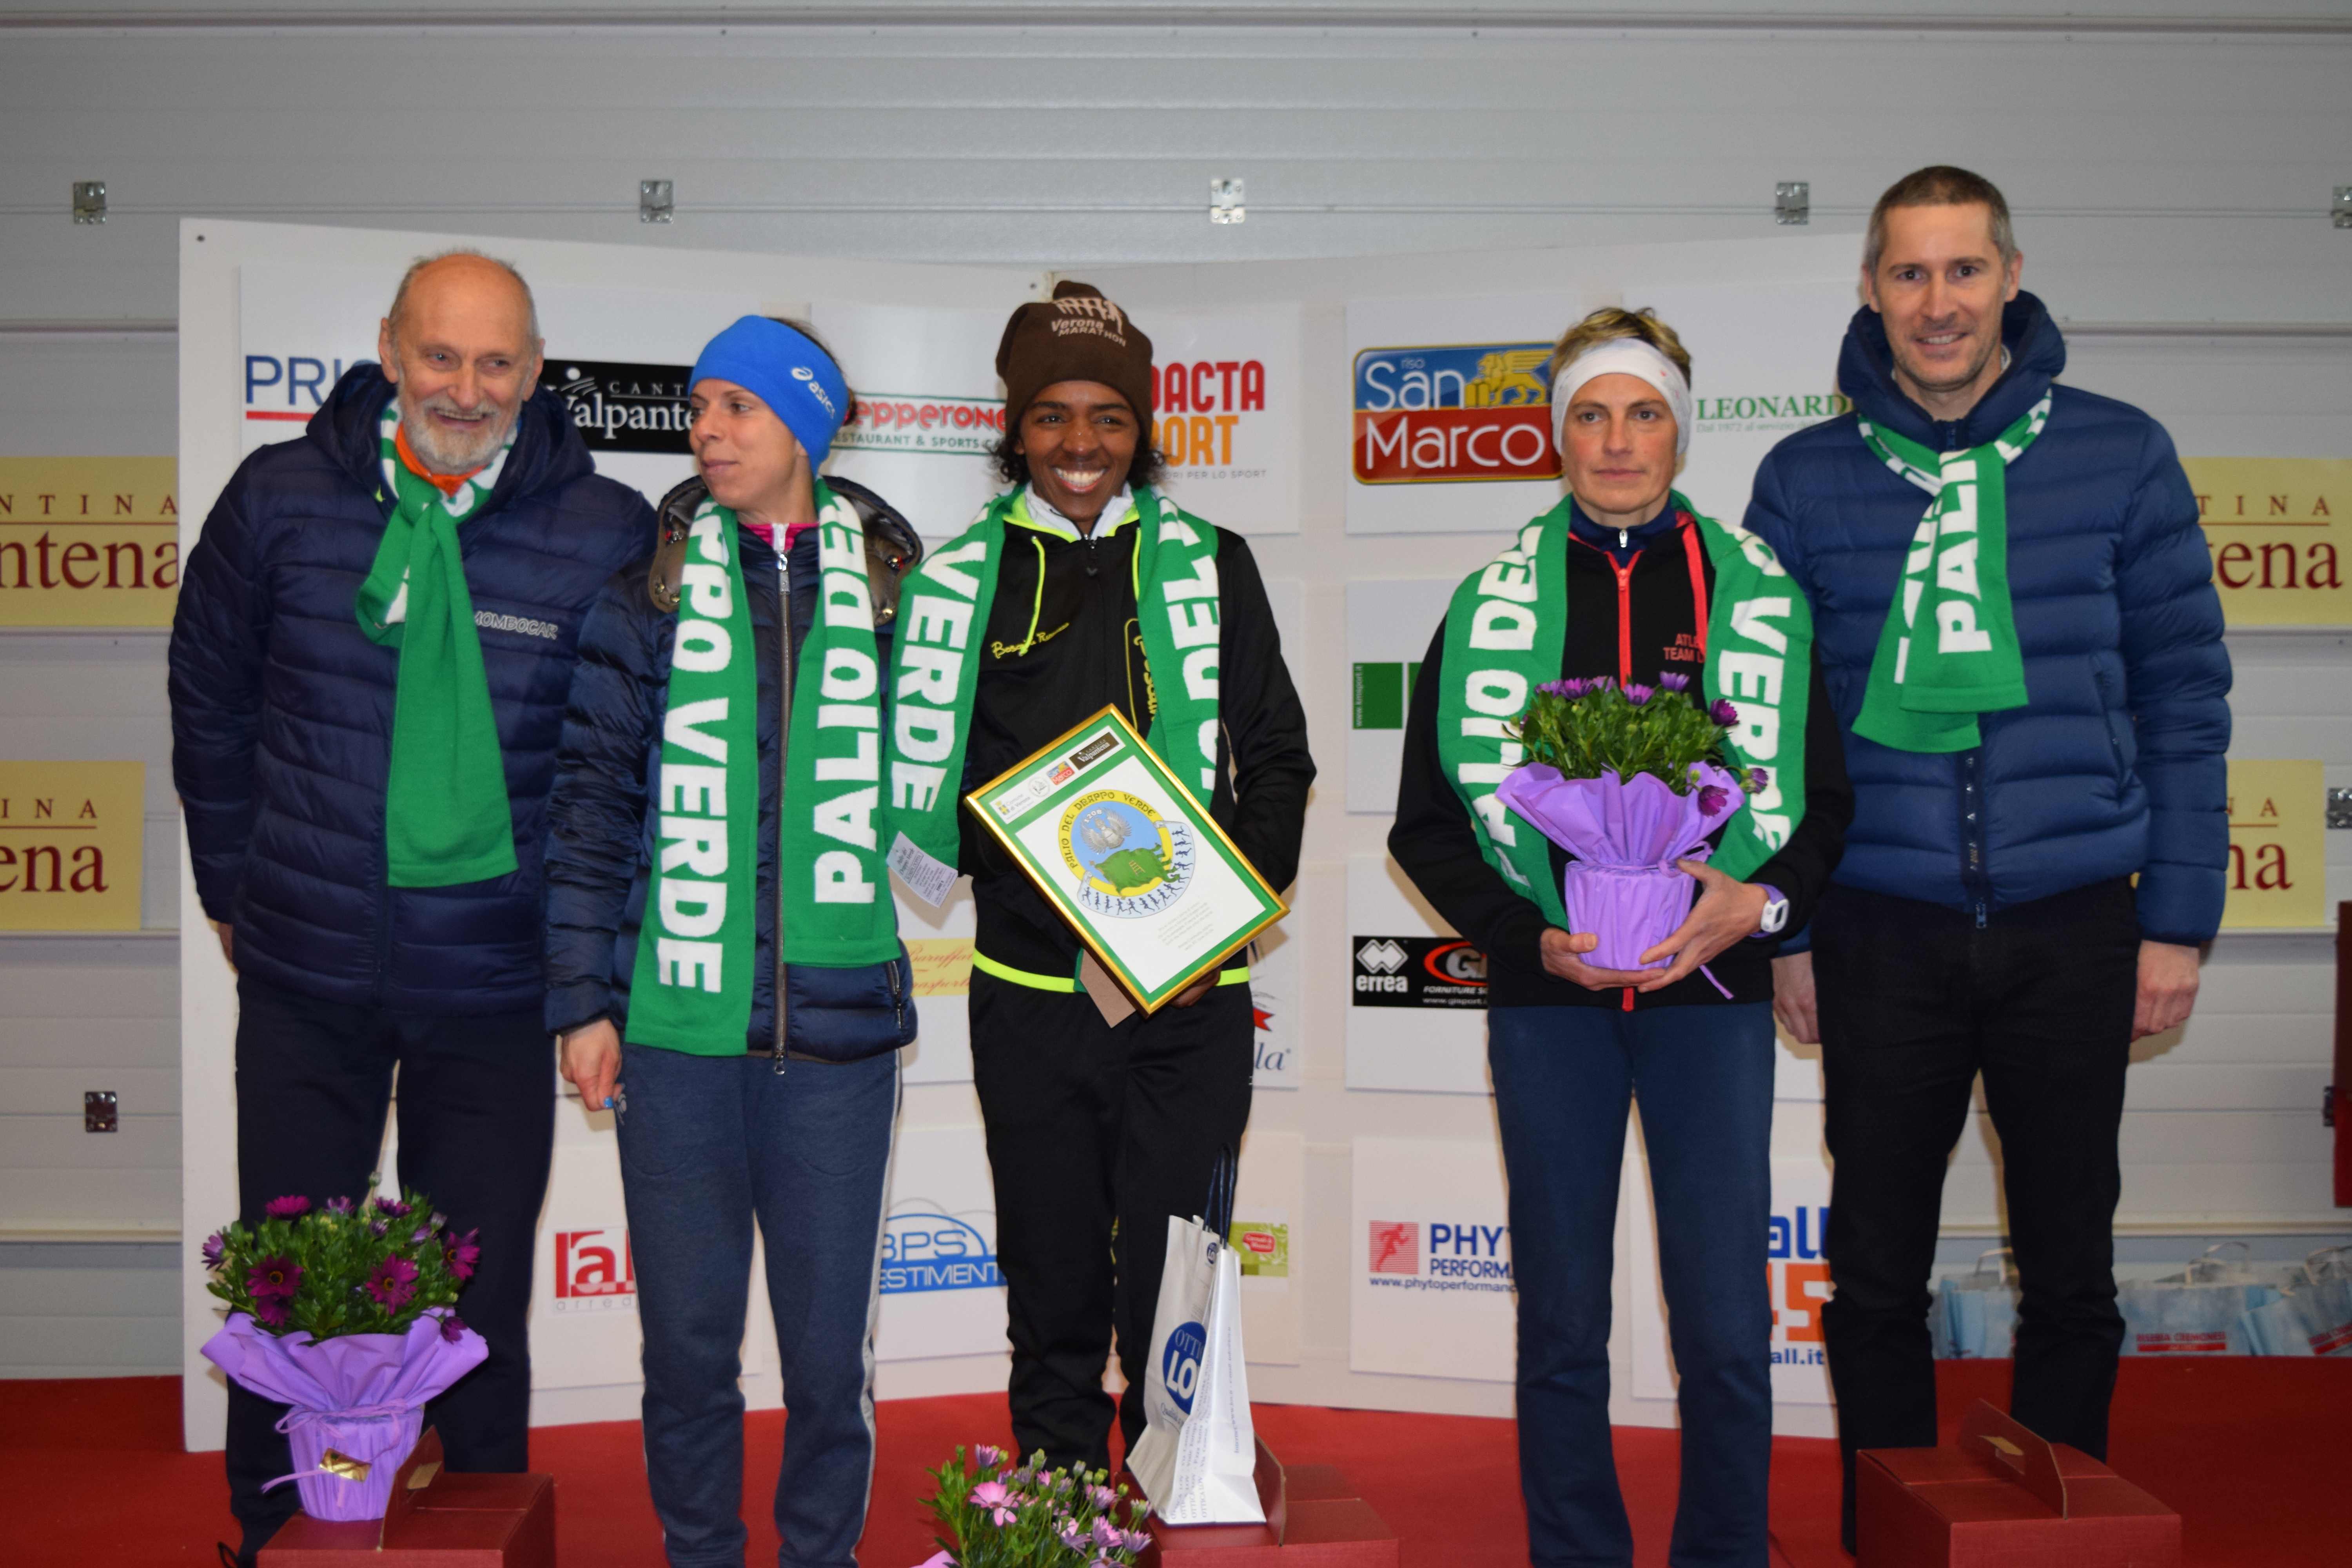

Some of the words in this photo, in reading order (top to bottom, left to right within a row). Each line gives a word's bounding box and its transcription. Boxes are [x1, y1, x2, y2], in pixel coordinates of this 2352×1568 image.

[1051, 318, 1104, 332] Verona
[1058, 327, 1127, 347] MARATHON
[1365, 361, 1465, 413] San
[808, 381, 835, 419] asics
[1696, 395, 1855, 420] LEONARD
[1366, 416, 1546, 470] Marco
[1936, 449, 1992, 654] PALI
[2207, 541, 2343, 589] ena
[1663, 646, 1695, 662] TEAM
[891, 541, 986, 813] VERDE
[1077, 741, 1111, 763] Valpantena
[814, 647, 879, 904] PALIO
[1048, 769, 1059, 779] San
[1052, 768, 1073, 784] Marco
[1005, 793, 1024, 807] Comune
[1015, 796, 1032, 809] Verona
[1062, 813, 1075, 832] DEL
[1083, 809, 1103, 824] 1208
[657, 697, 729, 993] VERDE
[1356, 975, 1408, 993] errea
[1423, 985, 1475, 995] FORNITURE
[1430, 1223, 1509, 1257] PHY
[1430, 1258, 1512, 1279] PERFORM
[1166, 1349, 1200, 1400] LO
